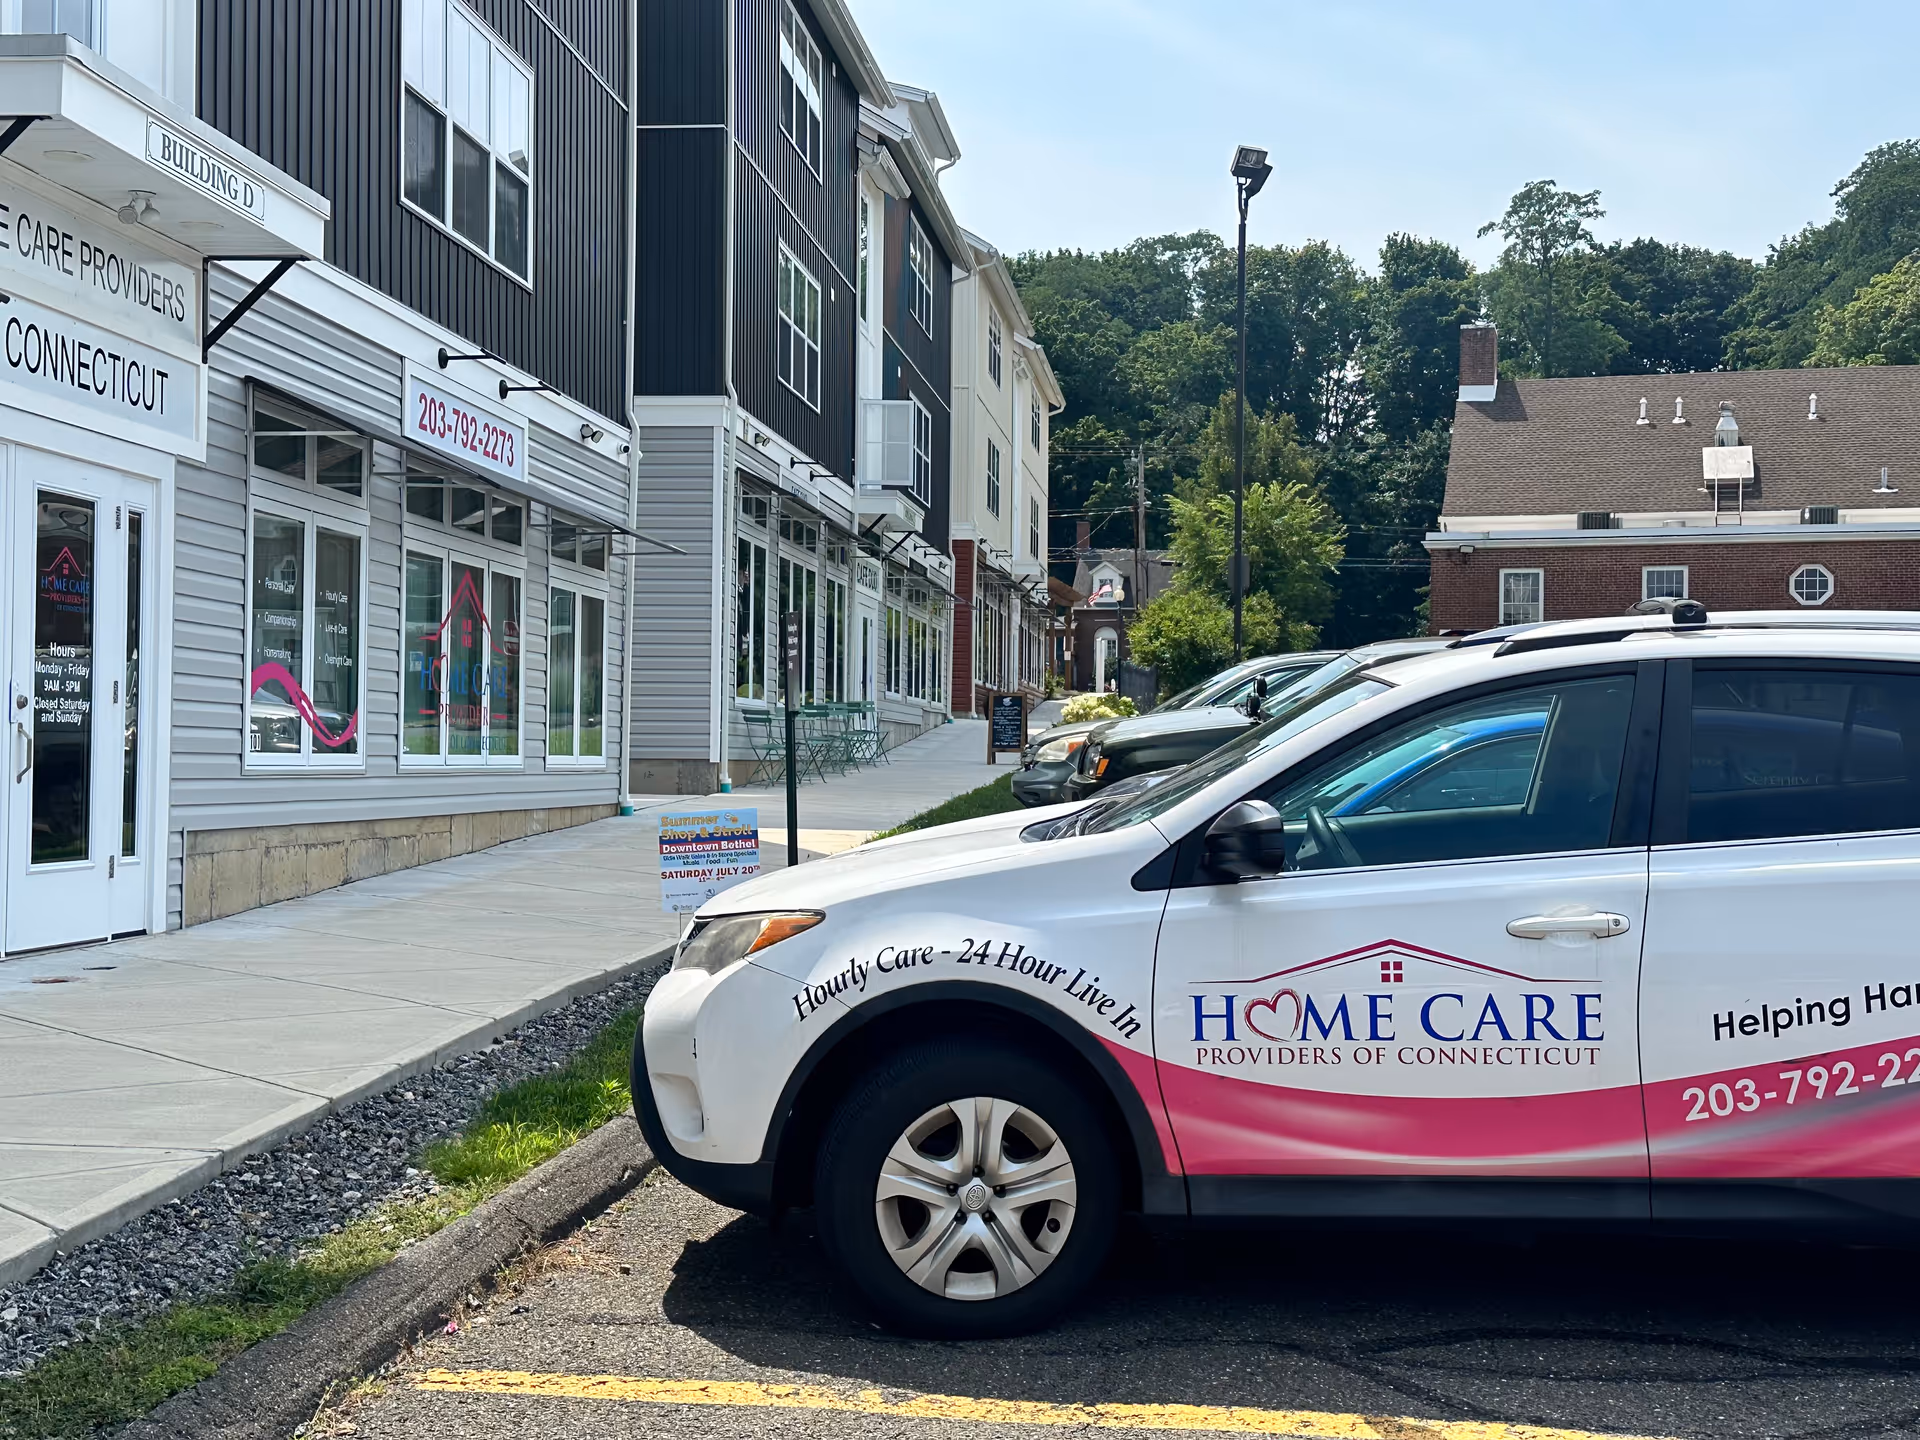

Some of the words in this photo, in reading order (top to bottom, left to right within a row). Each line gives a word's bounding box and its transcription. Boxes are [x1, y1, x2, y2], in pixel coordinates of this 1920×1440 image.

[161, 133, 239, 201] BUILDING
[243, 182, 255, 209] D
[17, 213, 74, 277] CARE
[80, 240, 185, 322] PROVIDERS
[6, 316, 169, 415] CONNECTICUT
[418, 392, 514, 468] 203-792-2273
[50, 642, 76, 658] Hours
[35, 660, 62, 677] Monday
[68, 663, 91, 679] Friday
[43, 680, 60, 691] 9AM
[65, 681, 81, 692] 5PM
[34, 697, 58, 709] Closed
[59, 698, 91, 713] Saturday
[41, 711, 55, 722] and
[56, 711, 82, 726] Sunday
[660, 815, 719, 827] Summer
[661, 828, 697, 841] Shop
[699, 827, 709, 838] &
[713, 824, 753, 837] Stroll
[662, 842, 719, 853] Downtown
[721, 839, 756, 850] Bethel
[661, 868, 713, 880] SATURDAY
[716, 866, 739, 876] JULY
[792, 957, 870, 1022] Hourly
[876, 945, 934, 974] Care
[957, 938, 992, 965] 24
[994, 941, 1068, 985] Hour
[1064, 967, 1116, 1016] Live
[1110, 1003, 1143, 1040] In
[1188, 988, 1396, 1042] HOME
[1420, 993, 1604, 1042] CARE
[1713, 996, 1850, 1041] Helping
[1864, 982, 1920, 1013] Ha
[1196, 1047, 1342, 1065] PROVIDERS
[1353, 1047, 1386, 1065] OF
[1397, 1047, 1601, 1066] CONNECTICUT
